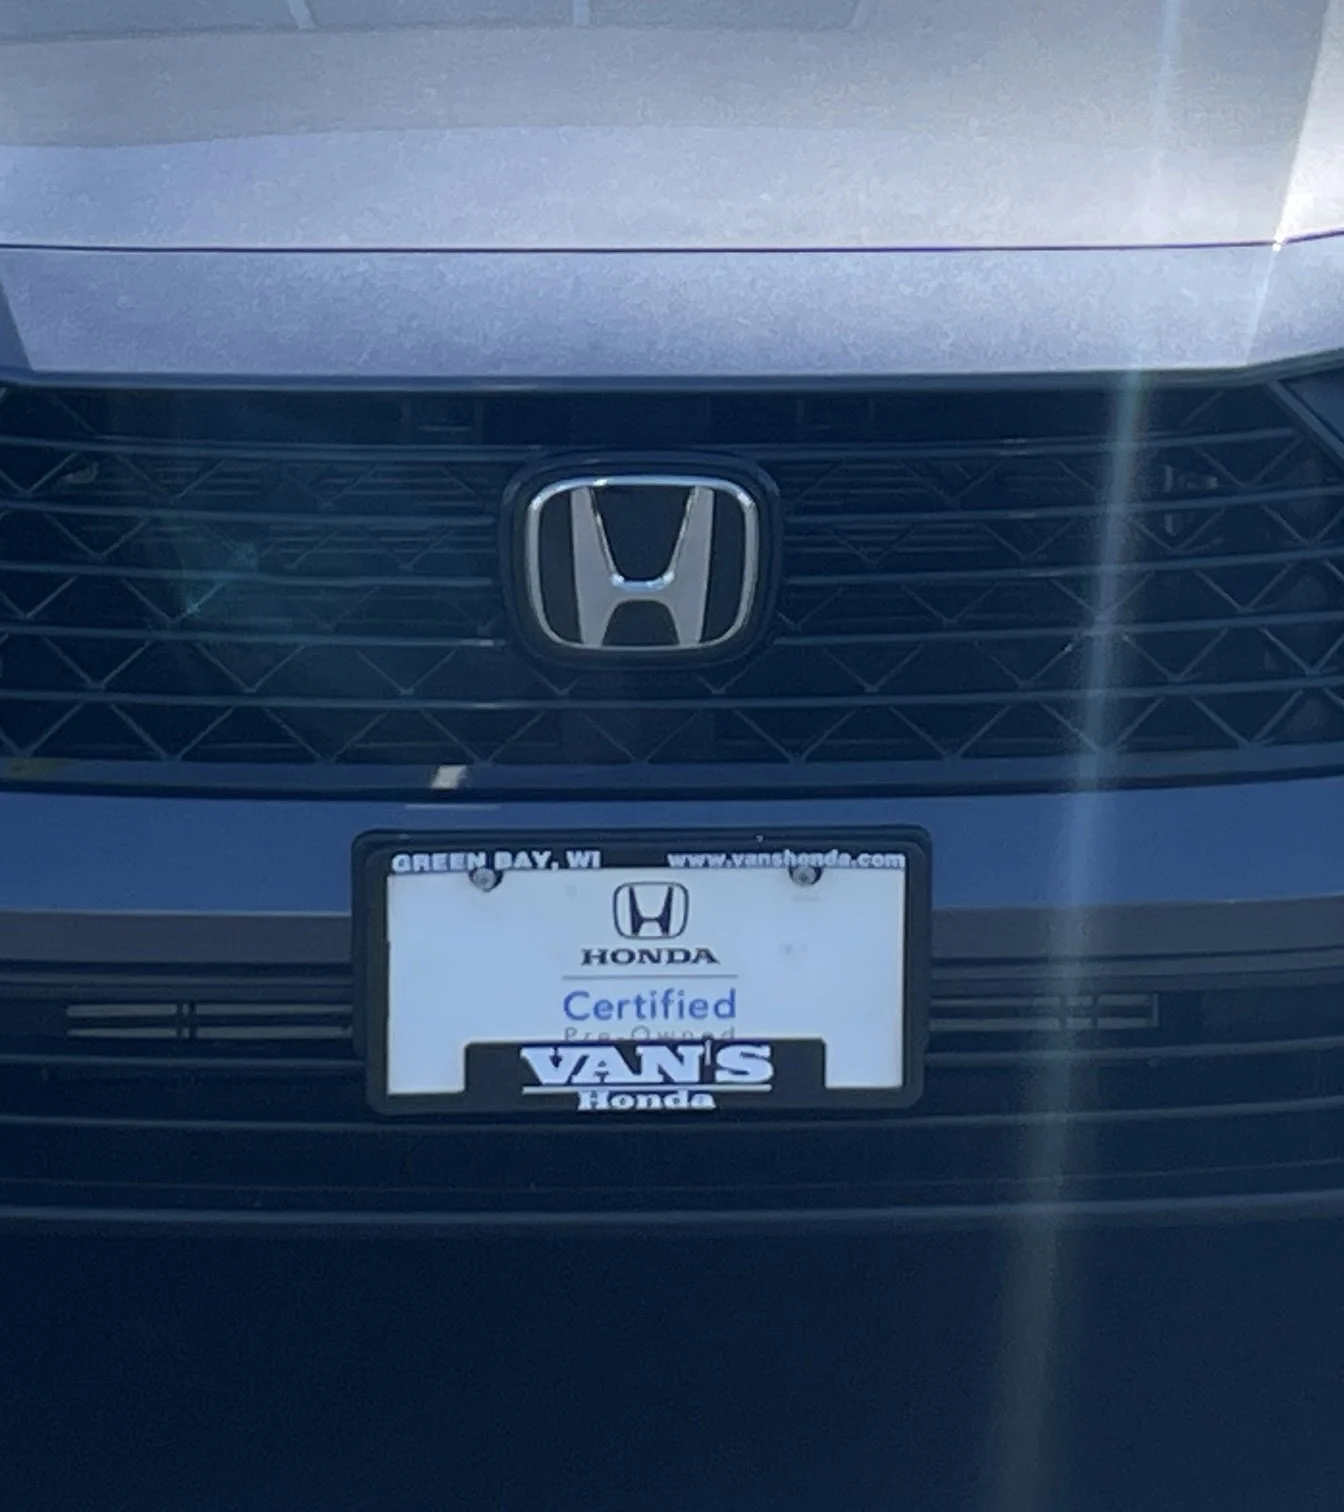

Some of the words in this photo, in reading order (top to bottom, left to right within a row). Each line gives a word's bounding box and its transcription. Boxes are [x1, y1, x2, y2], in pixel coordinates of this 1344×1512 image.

[391, 850, 487, 873] GREEN
[493, 850, 559, 872] BAY,
[565, 849, 601, 869] WI
[667, 848, 906, 868] www.vanshonda.com
[580, 947, 721, 966] HONDA
[563, 987, 737, 1021] Certified
[577, 1090, 717, 1111] Honda
